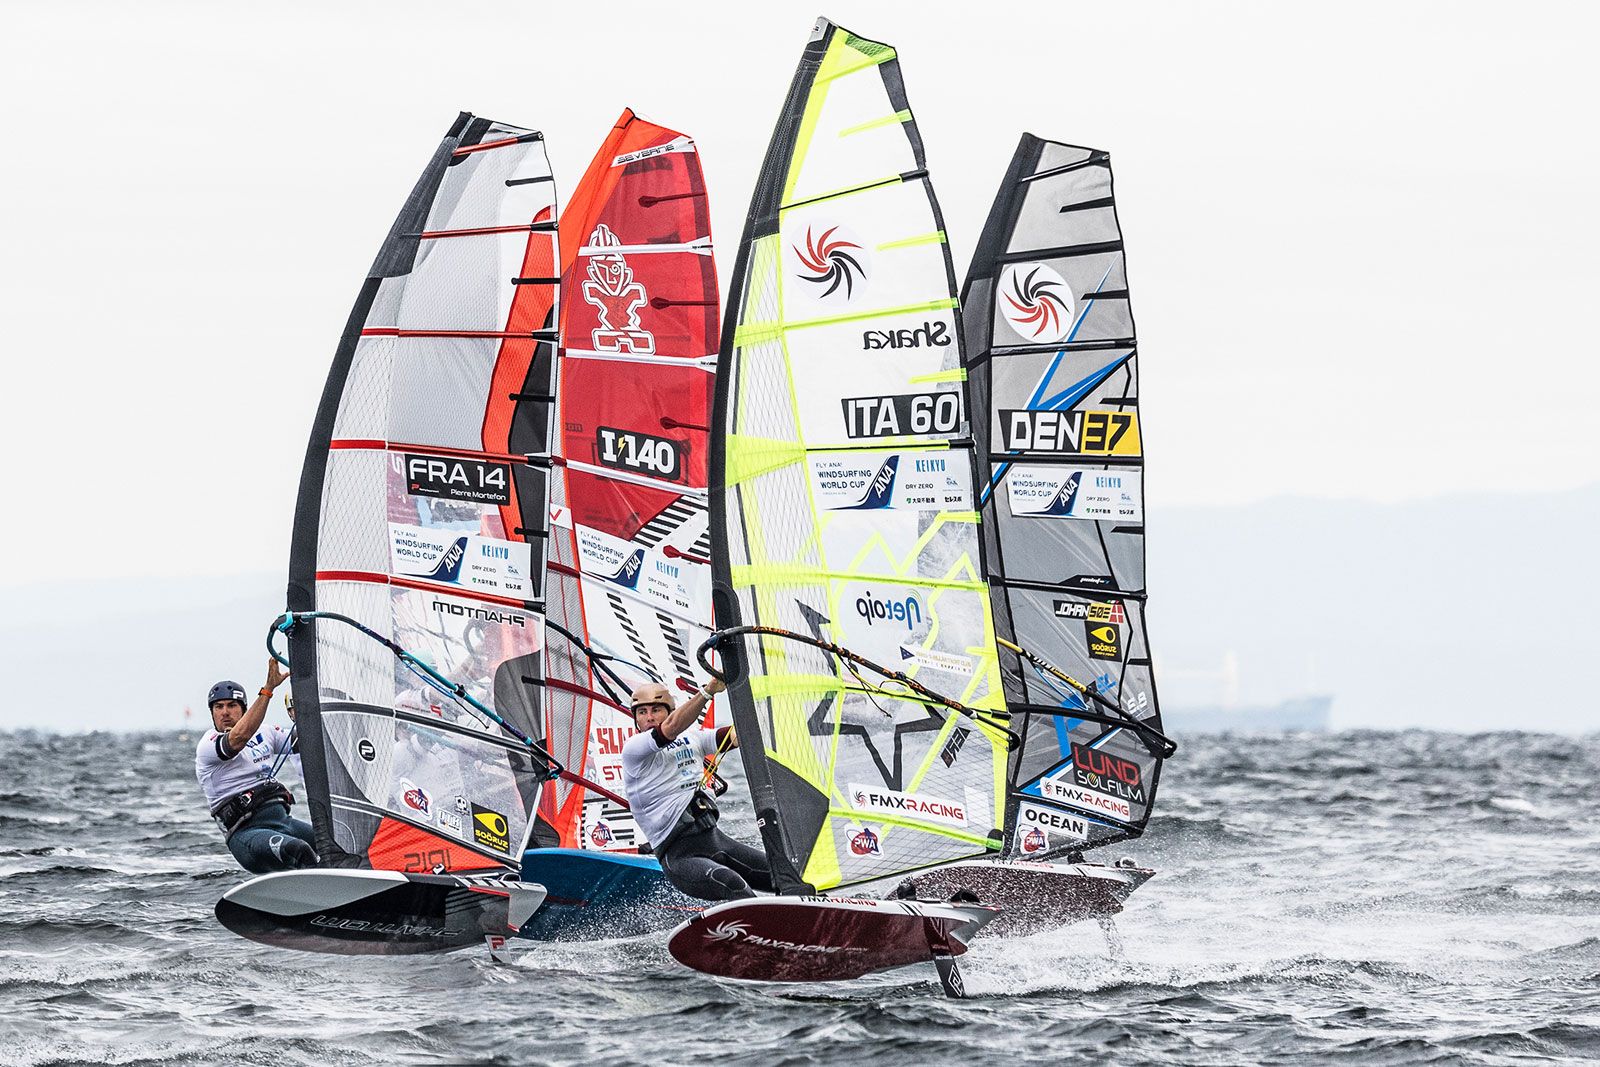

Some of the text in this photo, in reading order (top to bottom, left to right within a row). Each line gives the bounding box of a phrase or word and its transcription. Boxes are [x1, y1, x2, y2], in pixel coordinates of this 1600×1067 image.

[848, 394, 959, 437] ITA 60
[1009, 411, 1132, 451] DEN 37
[624, 434, 675, 474] 140
[915, 459, 946, 472] KEIKYU
[409, 459, 506, 490] FRA 14
[818, 470, 872, 478] WINDSURFING
[820, 481, 848, 489] WORLD
[874, 465, 895, 498] ANA
[450, 488, 472, 498] Pierre
[472, 491, 506, 501] Mortefon
[1060, 479, 1078, 507] ANA
[395, 539, 443, 553] WINDSURFING
[396, 548, 421, 558] WORLD
[422, 552, 437, 561] CUP
[444, 543, 464, 573] ANA
[482, 544, 509, 559] KEIKYU
[581, 539, 625, 560] WINDSURFING
[583, 548, 605, 561] WORLD
[605, 556, 619, 565] CUP
[625, 554, 642, 580] ANA
[1074, 746, 1139, 786] LUND
[1077, 770, 1143, 803] SOLFILM
[869, 793, 964, 820] FMXRACING
[1055, 785, 1129, 817] FMXRACING
[1025, 808, 1083, 834] OCEAN
[854, 837, 876, 849] PWA
